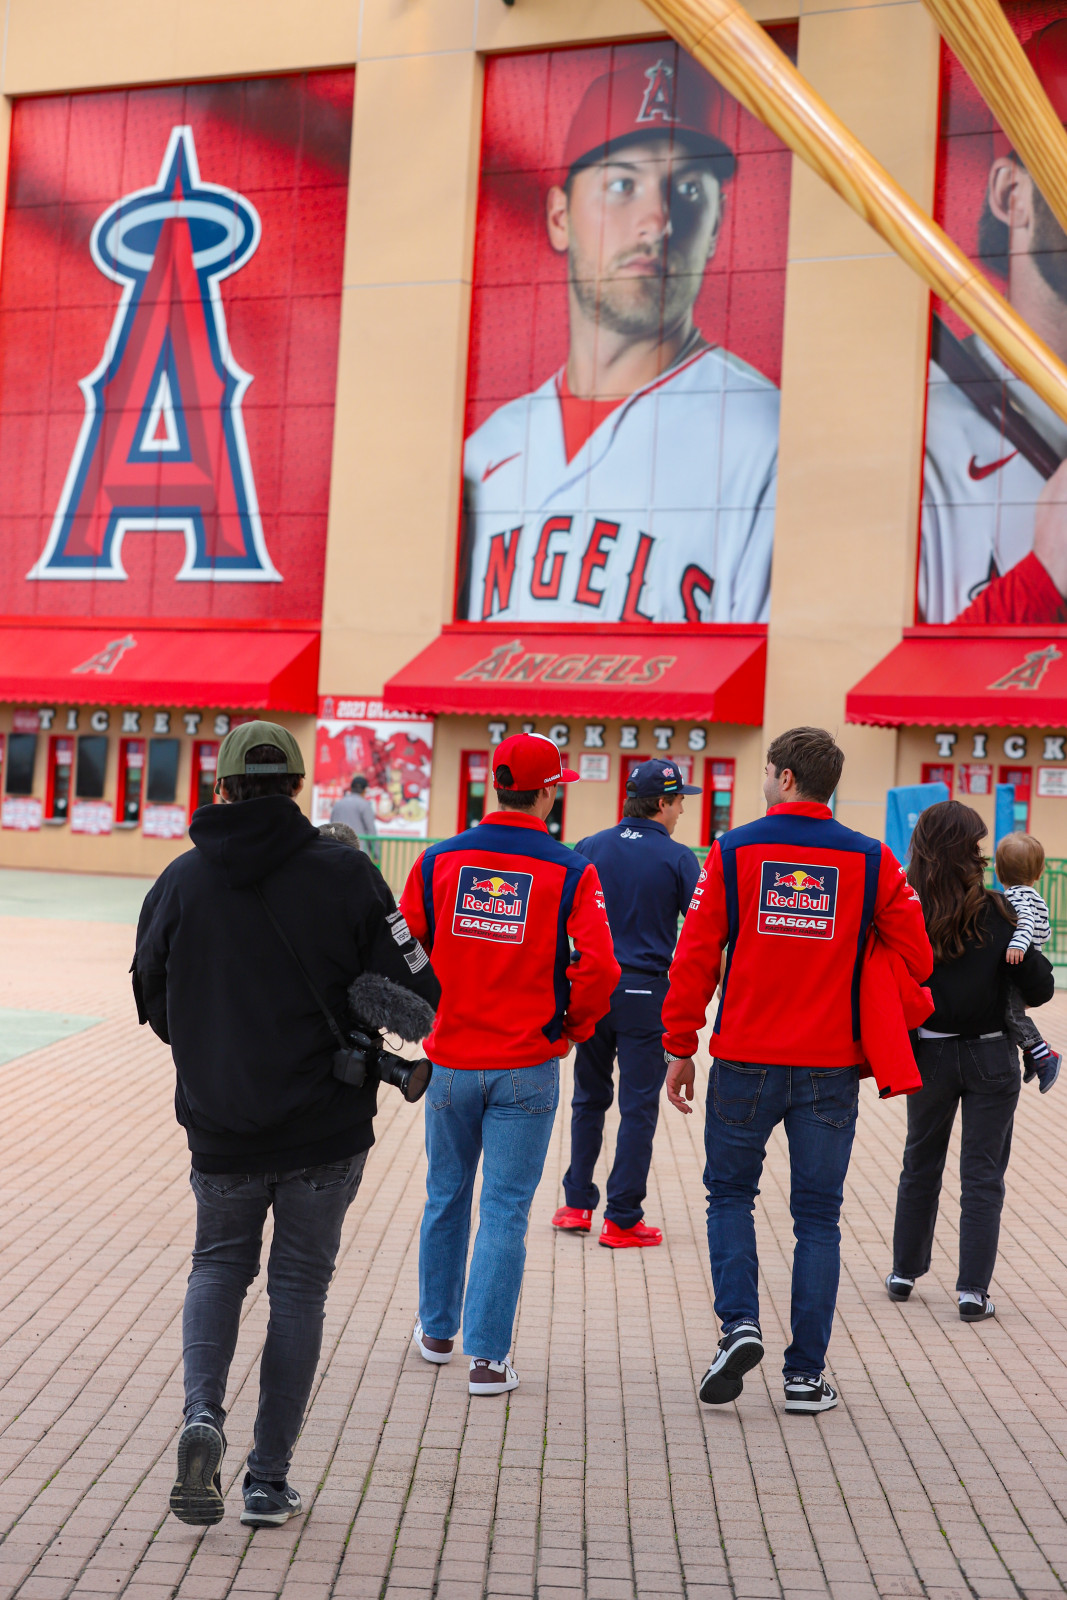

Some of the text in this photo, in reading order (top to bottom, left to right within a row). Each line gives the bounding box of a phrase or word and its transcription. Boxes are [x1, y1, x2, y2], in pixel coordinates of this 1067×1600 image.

[636, 59, 681, 122] A
[26, 125, 283, 582] A
[72, 634, 137, 675] A
[456, 639, 677, 685] ANGELS
[988, 644, 1063, 691] A
[39, 708, 230, 737] TICKETS
[935, 733, 1067, 760] TICK
[462, 893, 522, 916] Red Bull
[766, 889, 830, 911] Red Bull
[459, 918, 519, 935] GASGAS
[459, 928, 517, 940] FACTORY RACING
[764, 925, 798, 934] FACTORY
[765, 915, 828, 930] GASGAS
